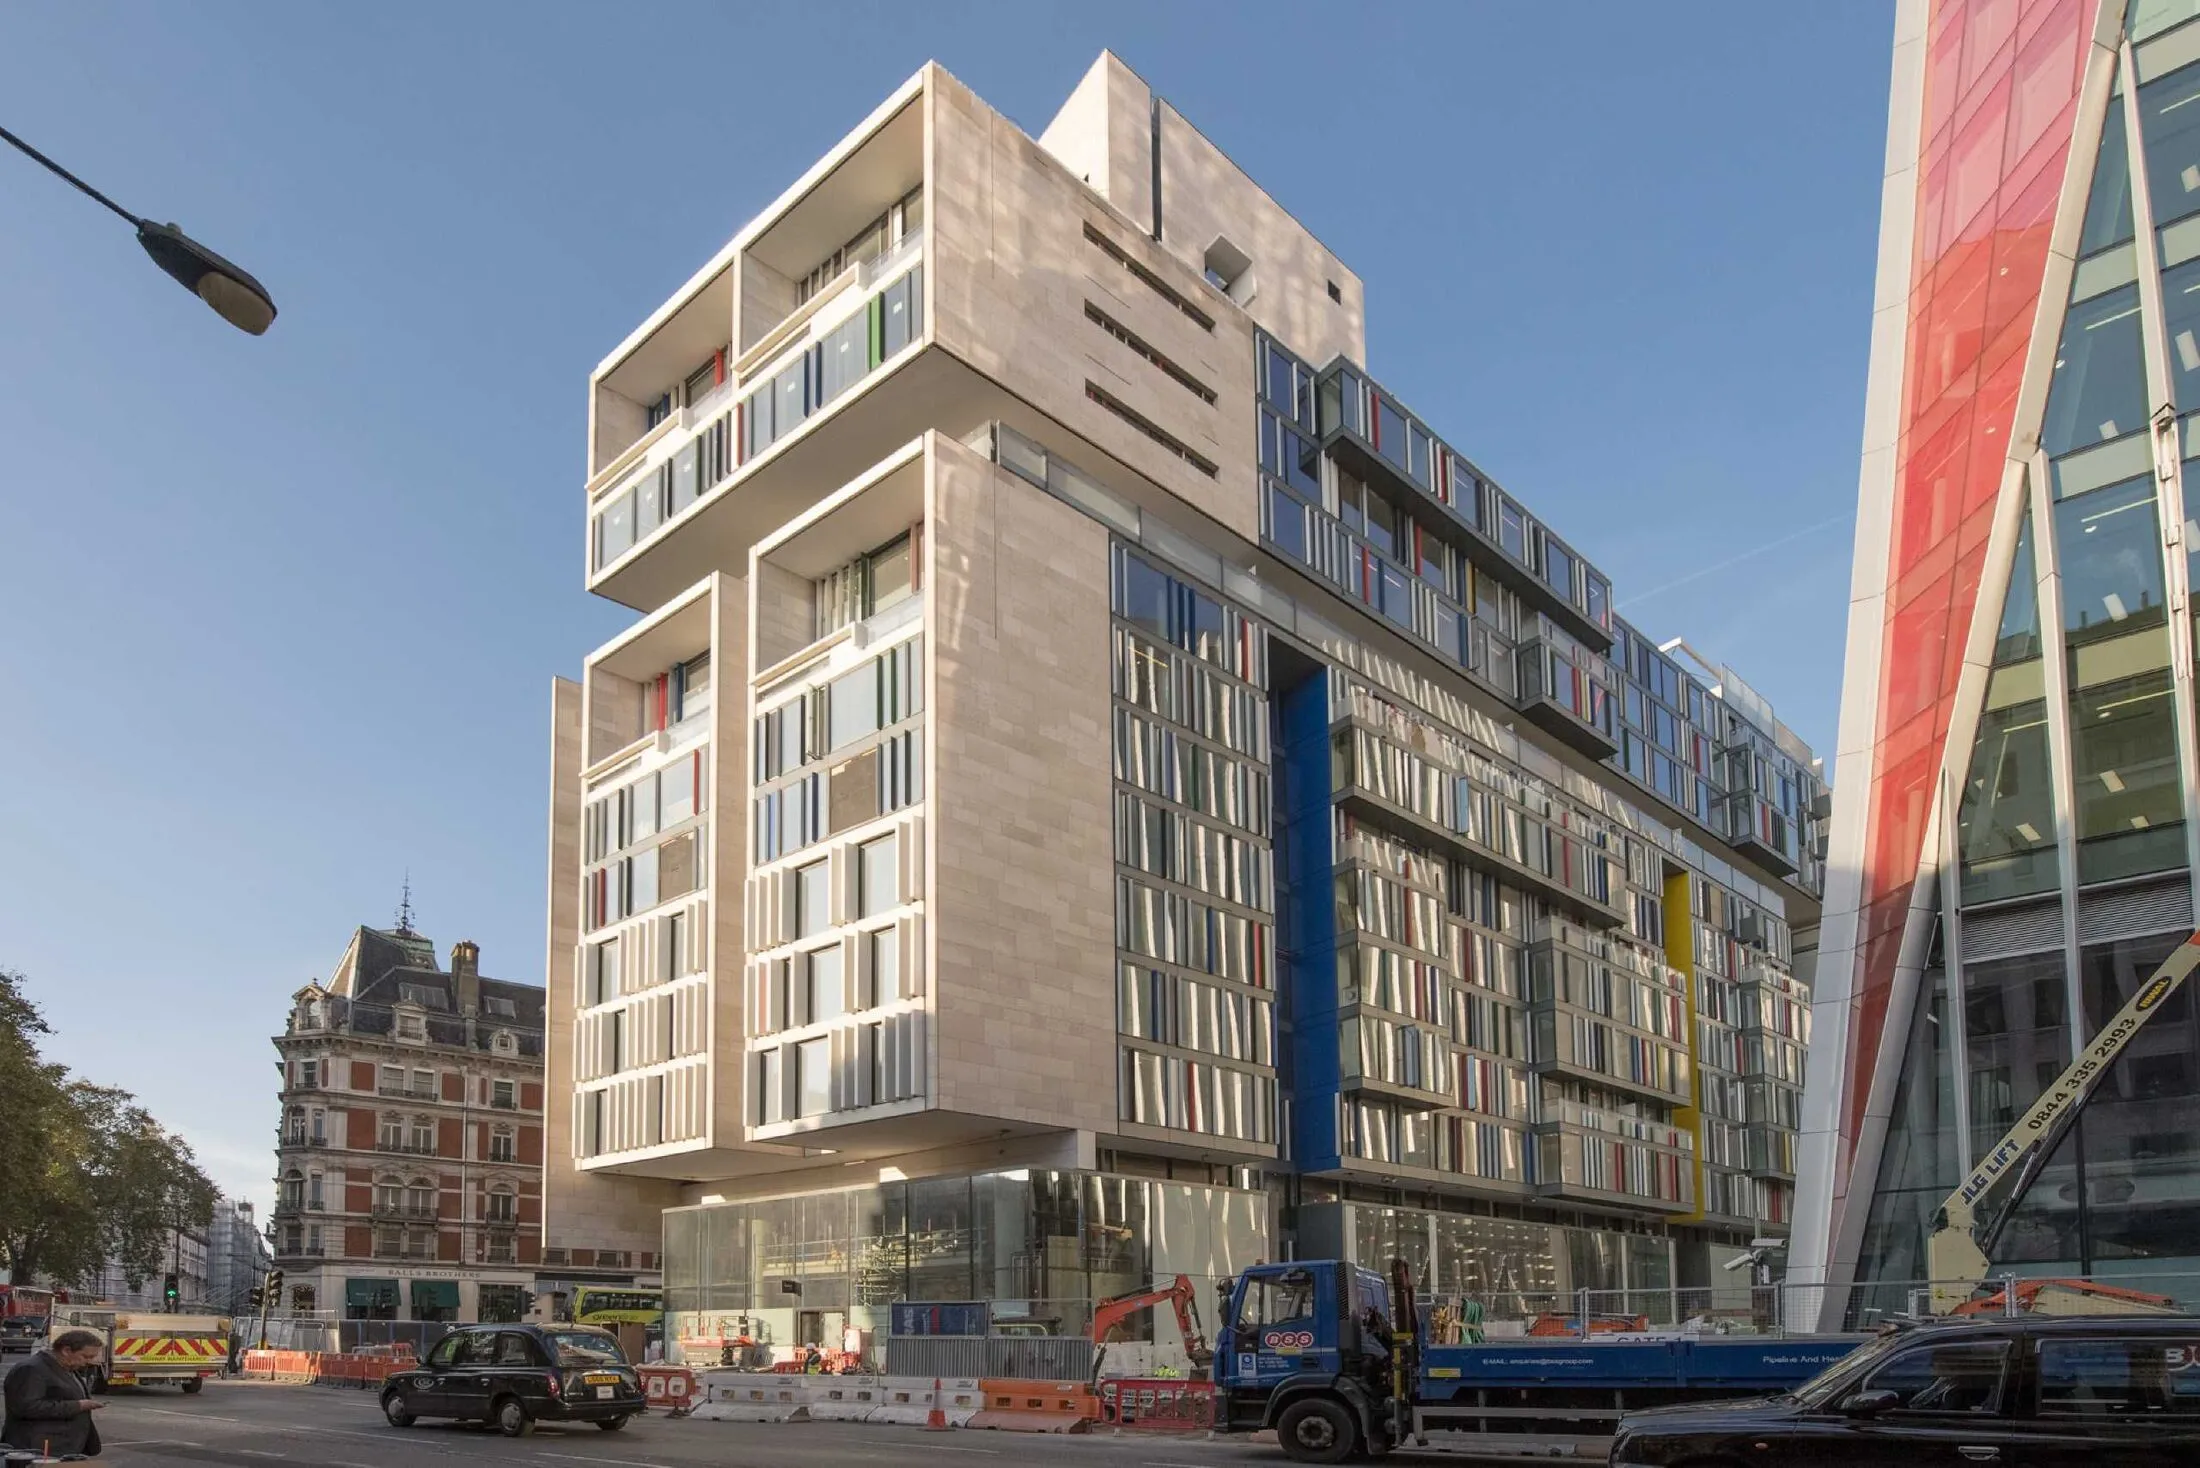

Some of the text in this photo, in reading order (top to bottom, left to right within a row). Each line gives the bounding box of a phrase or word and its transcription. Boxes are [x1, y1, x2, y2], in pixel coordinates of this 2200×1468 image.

[2027, 1018, 2136, 1130] 0844 335 2993
[1961, 1138, 2020, 1206] JLG LIFT
[1268, 1334, 1310, 1345] BSS
[1763, 1356, 1797, 1364] Pipeline
